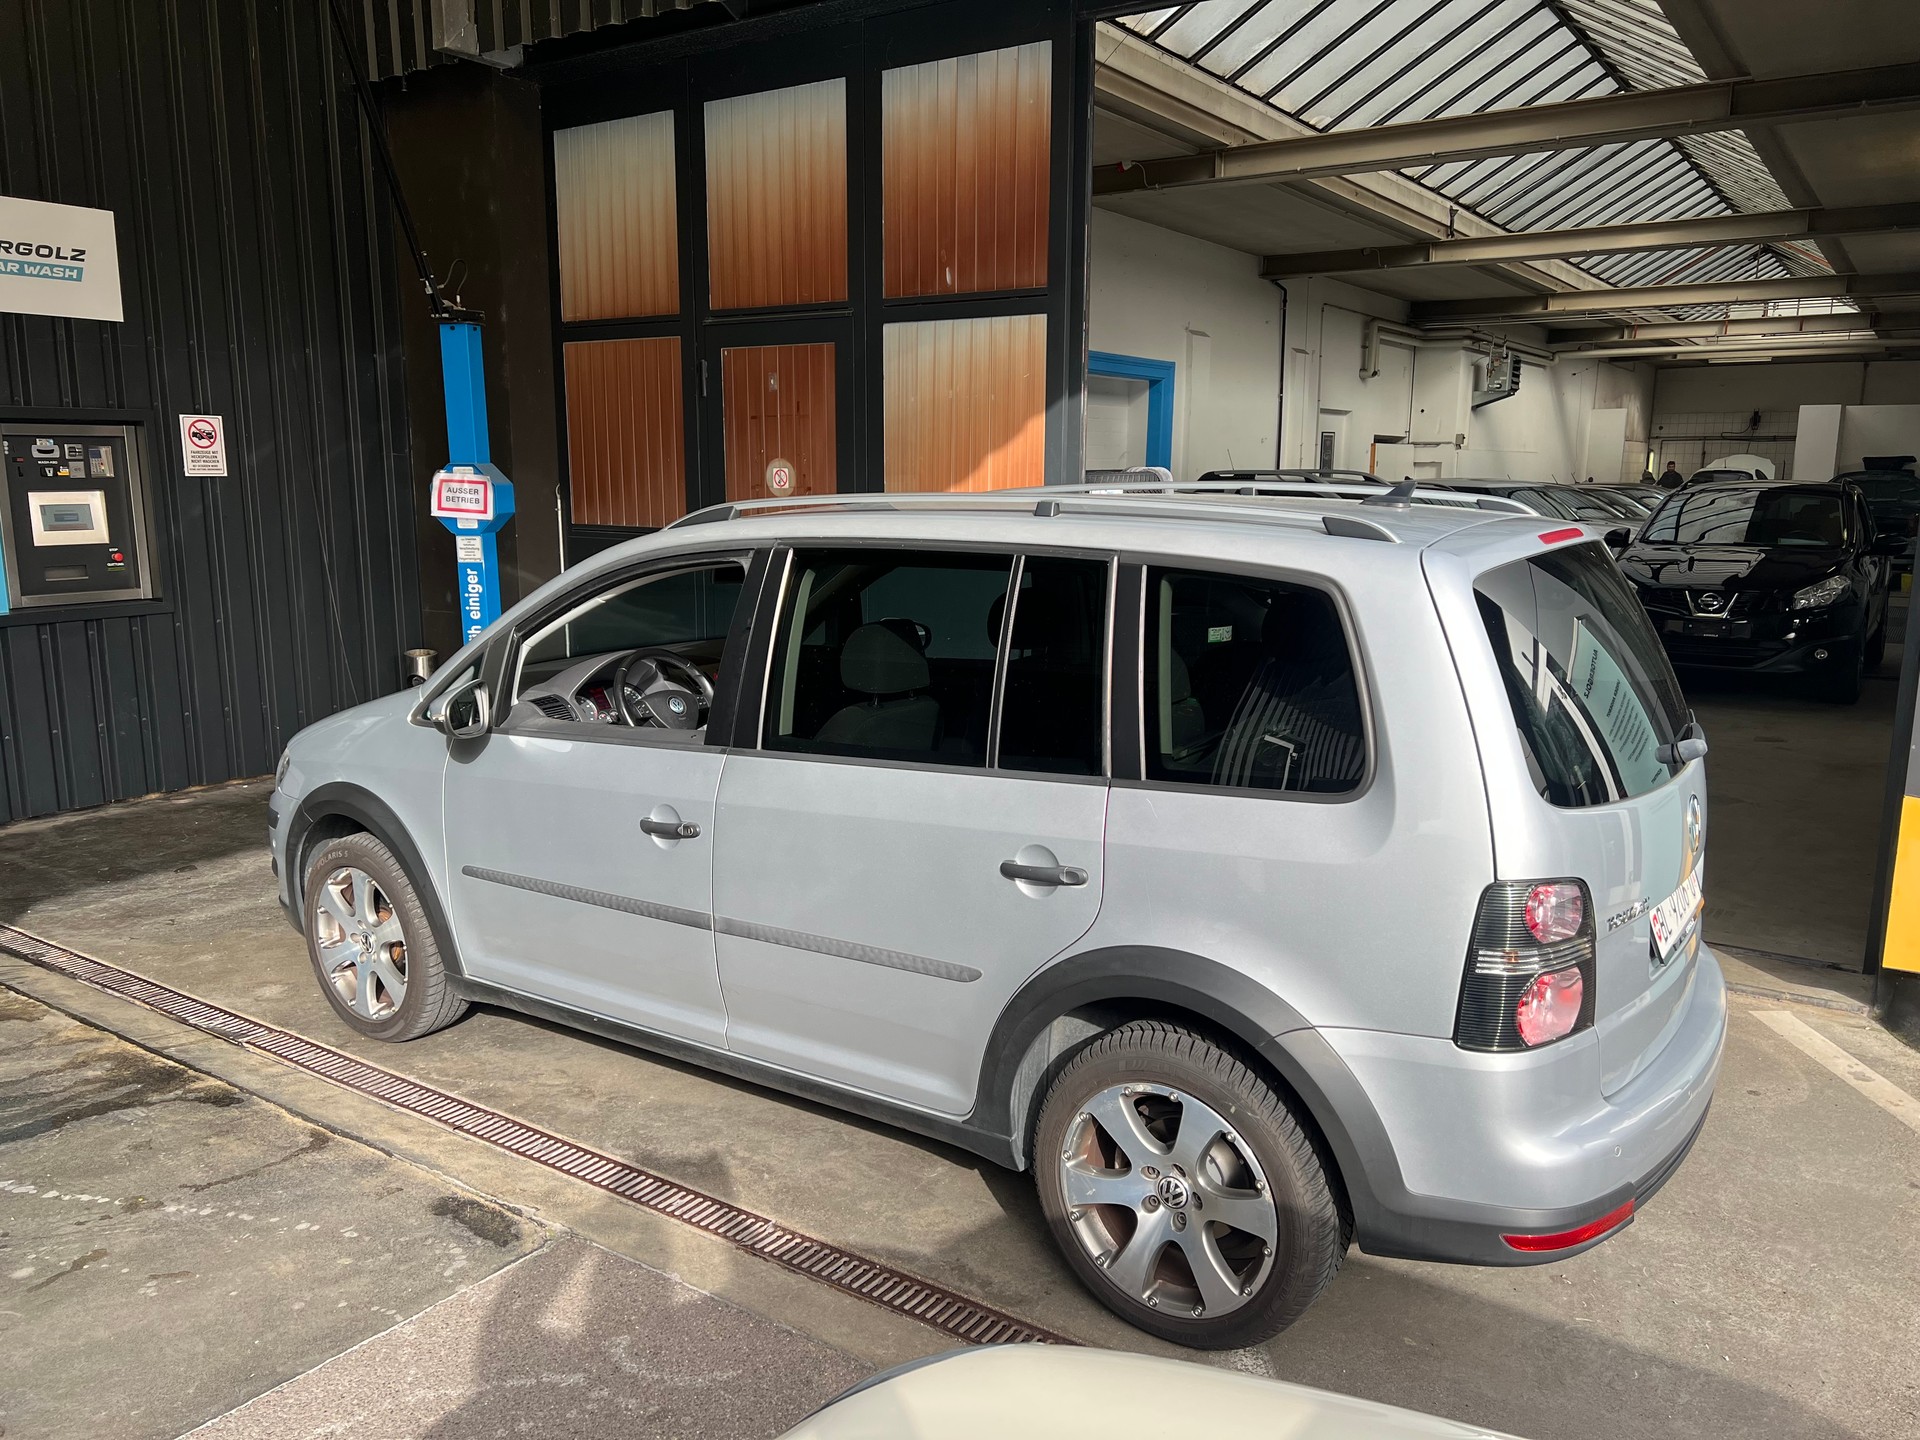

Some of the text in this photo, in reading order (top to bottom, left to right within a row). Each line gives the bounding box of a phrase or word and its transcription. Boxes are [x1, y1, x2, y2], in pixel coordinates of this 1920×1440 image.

[0, 240, 86, 262] RGOLZ
[24, 264, 77, 279] WASH
[446, 487, 479, 495] AUSSER
[446, 496, 480, 505] BETRIEB
[464, 568, 483, 620] einiger
